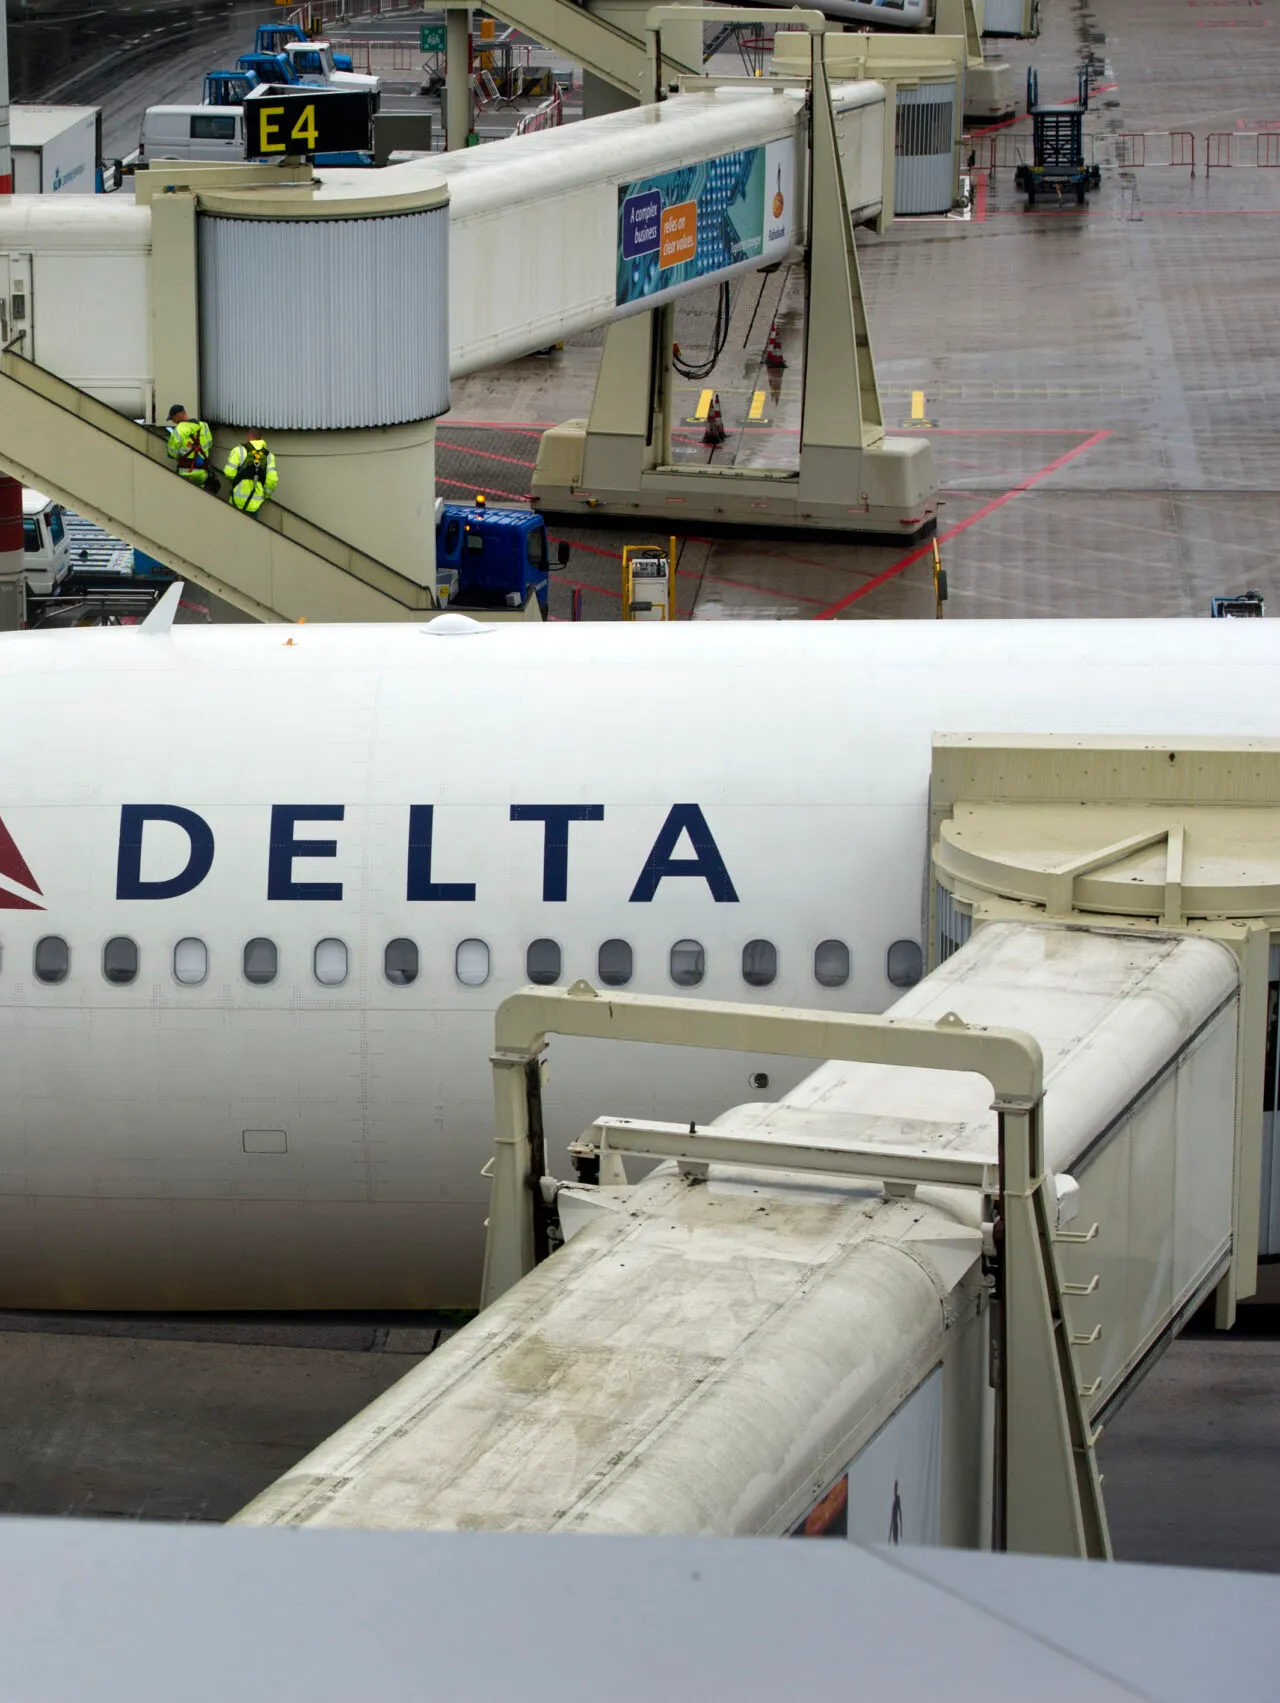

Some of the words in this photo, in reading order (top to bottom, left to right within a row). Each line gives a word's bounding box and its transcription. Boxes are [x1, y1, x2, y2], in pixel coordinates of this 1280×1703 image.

[260, 104, 319, 153] E4
[630, 207, 635, 224] A
[635, 201, 658, 223] complex
[634, 225, 658, 244] business
[663, 215, 678, 235] relies
[678, 216, 686, 230] on
[663, 239, 677, 256] clear
[116, 803, 741, 903] DELTA
